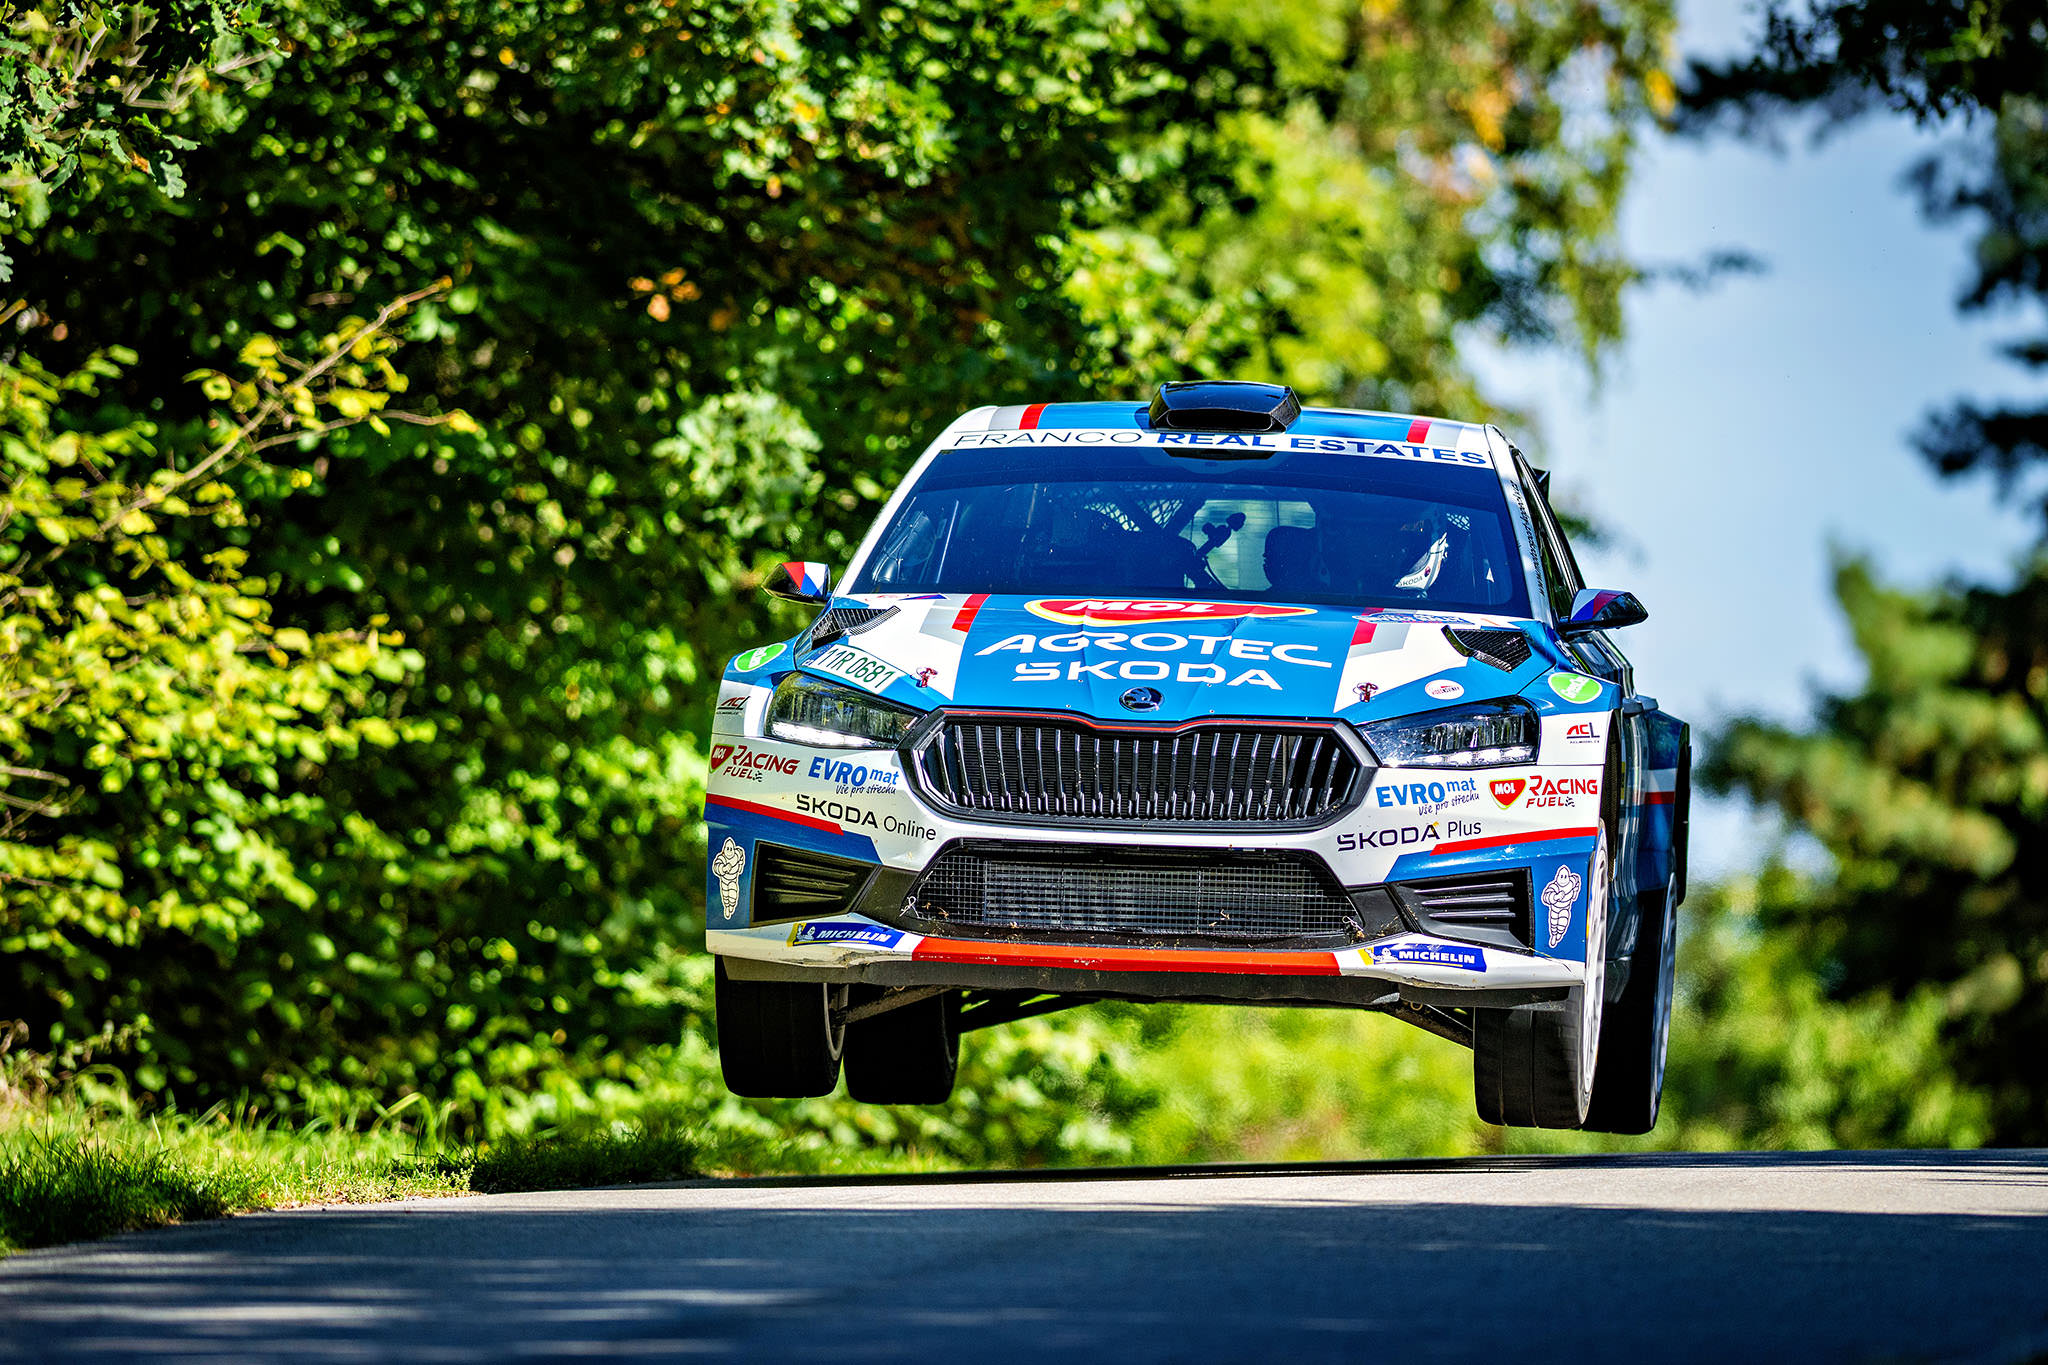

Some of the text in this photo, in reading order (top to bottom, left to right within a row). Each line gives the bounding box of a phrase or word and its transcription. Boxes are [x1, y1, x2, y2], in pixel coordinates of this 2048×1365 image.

[954, 432, 1487, 465] FRANCO REAL ESTATES
[1062, 601, 1215, 613] MOL
[974, 630, 1333, 668] AGROTEC
[1567, 722, 1600, 738] ACL
[731, 745, 800, 775] RACING
[808, 756, 900, 787] EVRO mat
[850, 786, 865, 797] pro
[1376, 777, 1477, 808] EVRO mat
[1495, 782, 1515, 795] MOL
[1528, 775, 1598, 796] RACING
[1435, 801, 1449, 815] pro
[883, 815, 937, 841] Online
[1447, 820, 1482, 838] Plus
[816, 929, 891, 943] MICHELIN
[1398, 950, 1475, 964] MICHELIN
